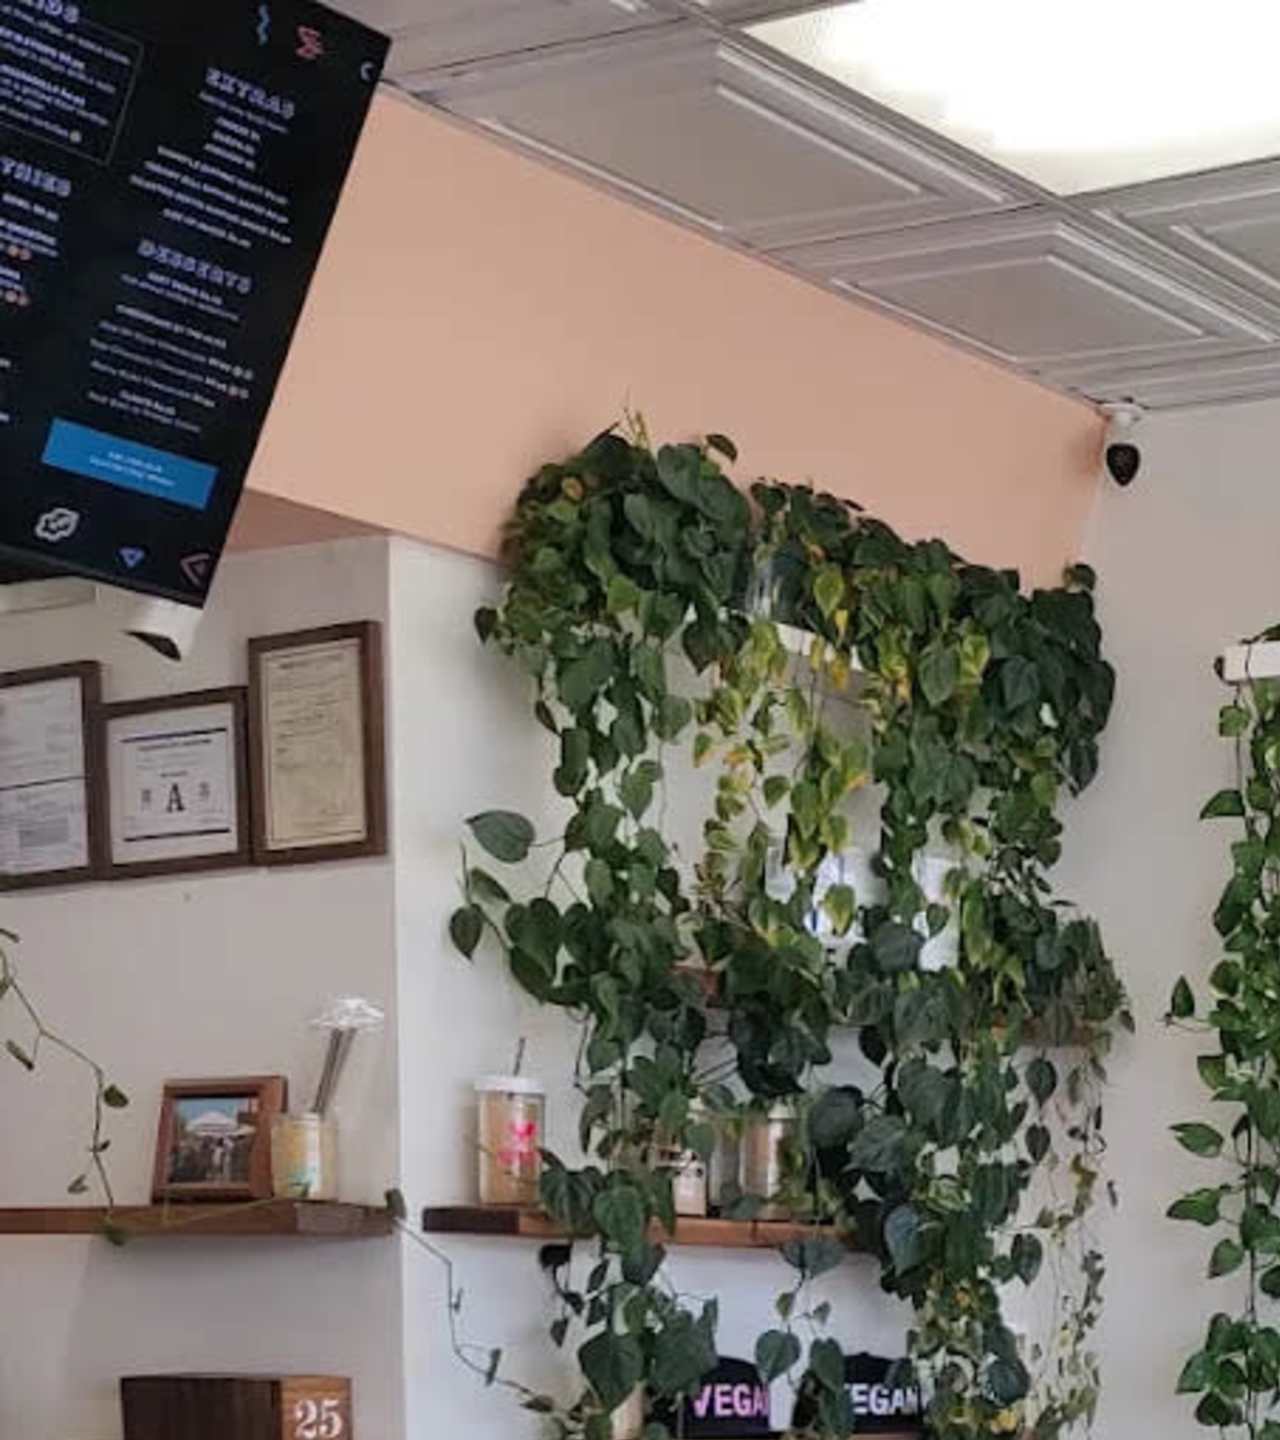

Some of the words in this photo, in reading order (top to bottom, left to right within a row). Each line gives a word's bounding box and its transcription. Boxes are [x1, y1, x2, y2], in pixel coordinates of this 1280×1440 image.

[165, 782, 186, 814] A
[843, 1382, 919, 1416] EGAN
[293, 1398, 344, 1440] 25
